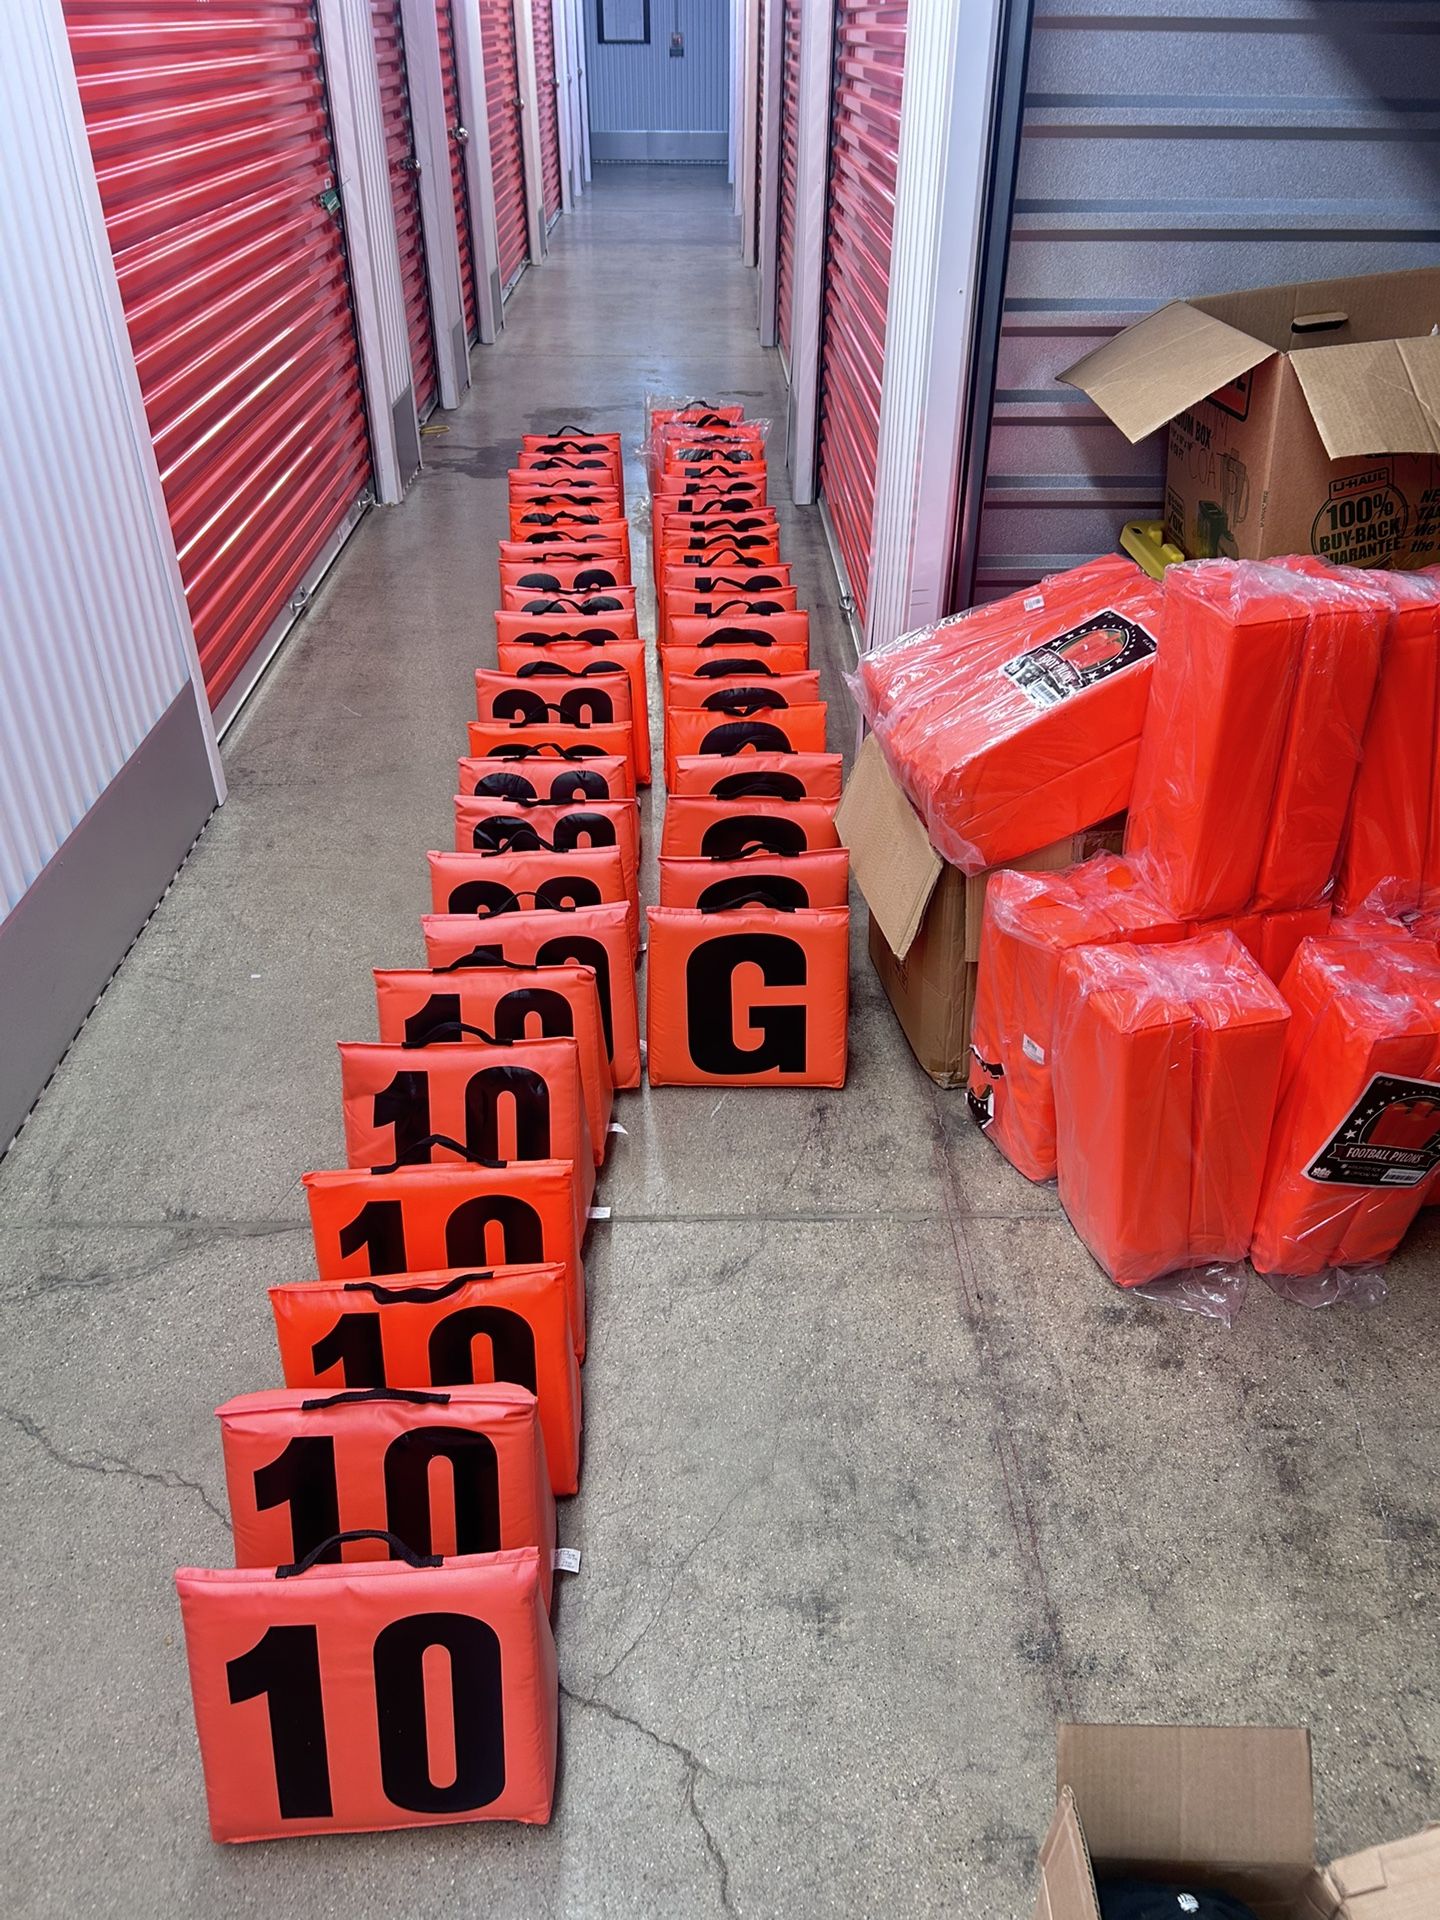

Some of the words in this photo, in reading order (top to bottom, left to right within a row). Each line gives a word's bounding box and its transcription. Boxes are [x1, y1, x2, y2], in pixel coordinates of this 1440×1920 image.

[1326, 489, 1395, 531] 100%
[1333, 470, 1387, 493] U-HAUL
[1319, 516, 1401, 554] BUY-BACK
[686, 932, 807, 1076] G
[373, 1065, 551, 1164] 10
[1346, 1147, 1391, 1161] FOOTBALL
[1389, 1151, 1424, 1164] PYLONS
[253, 1425, 503, 1564] 10
[226, 1611, 506, 1819] 10
